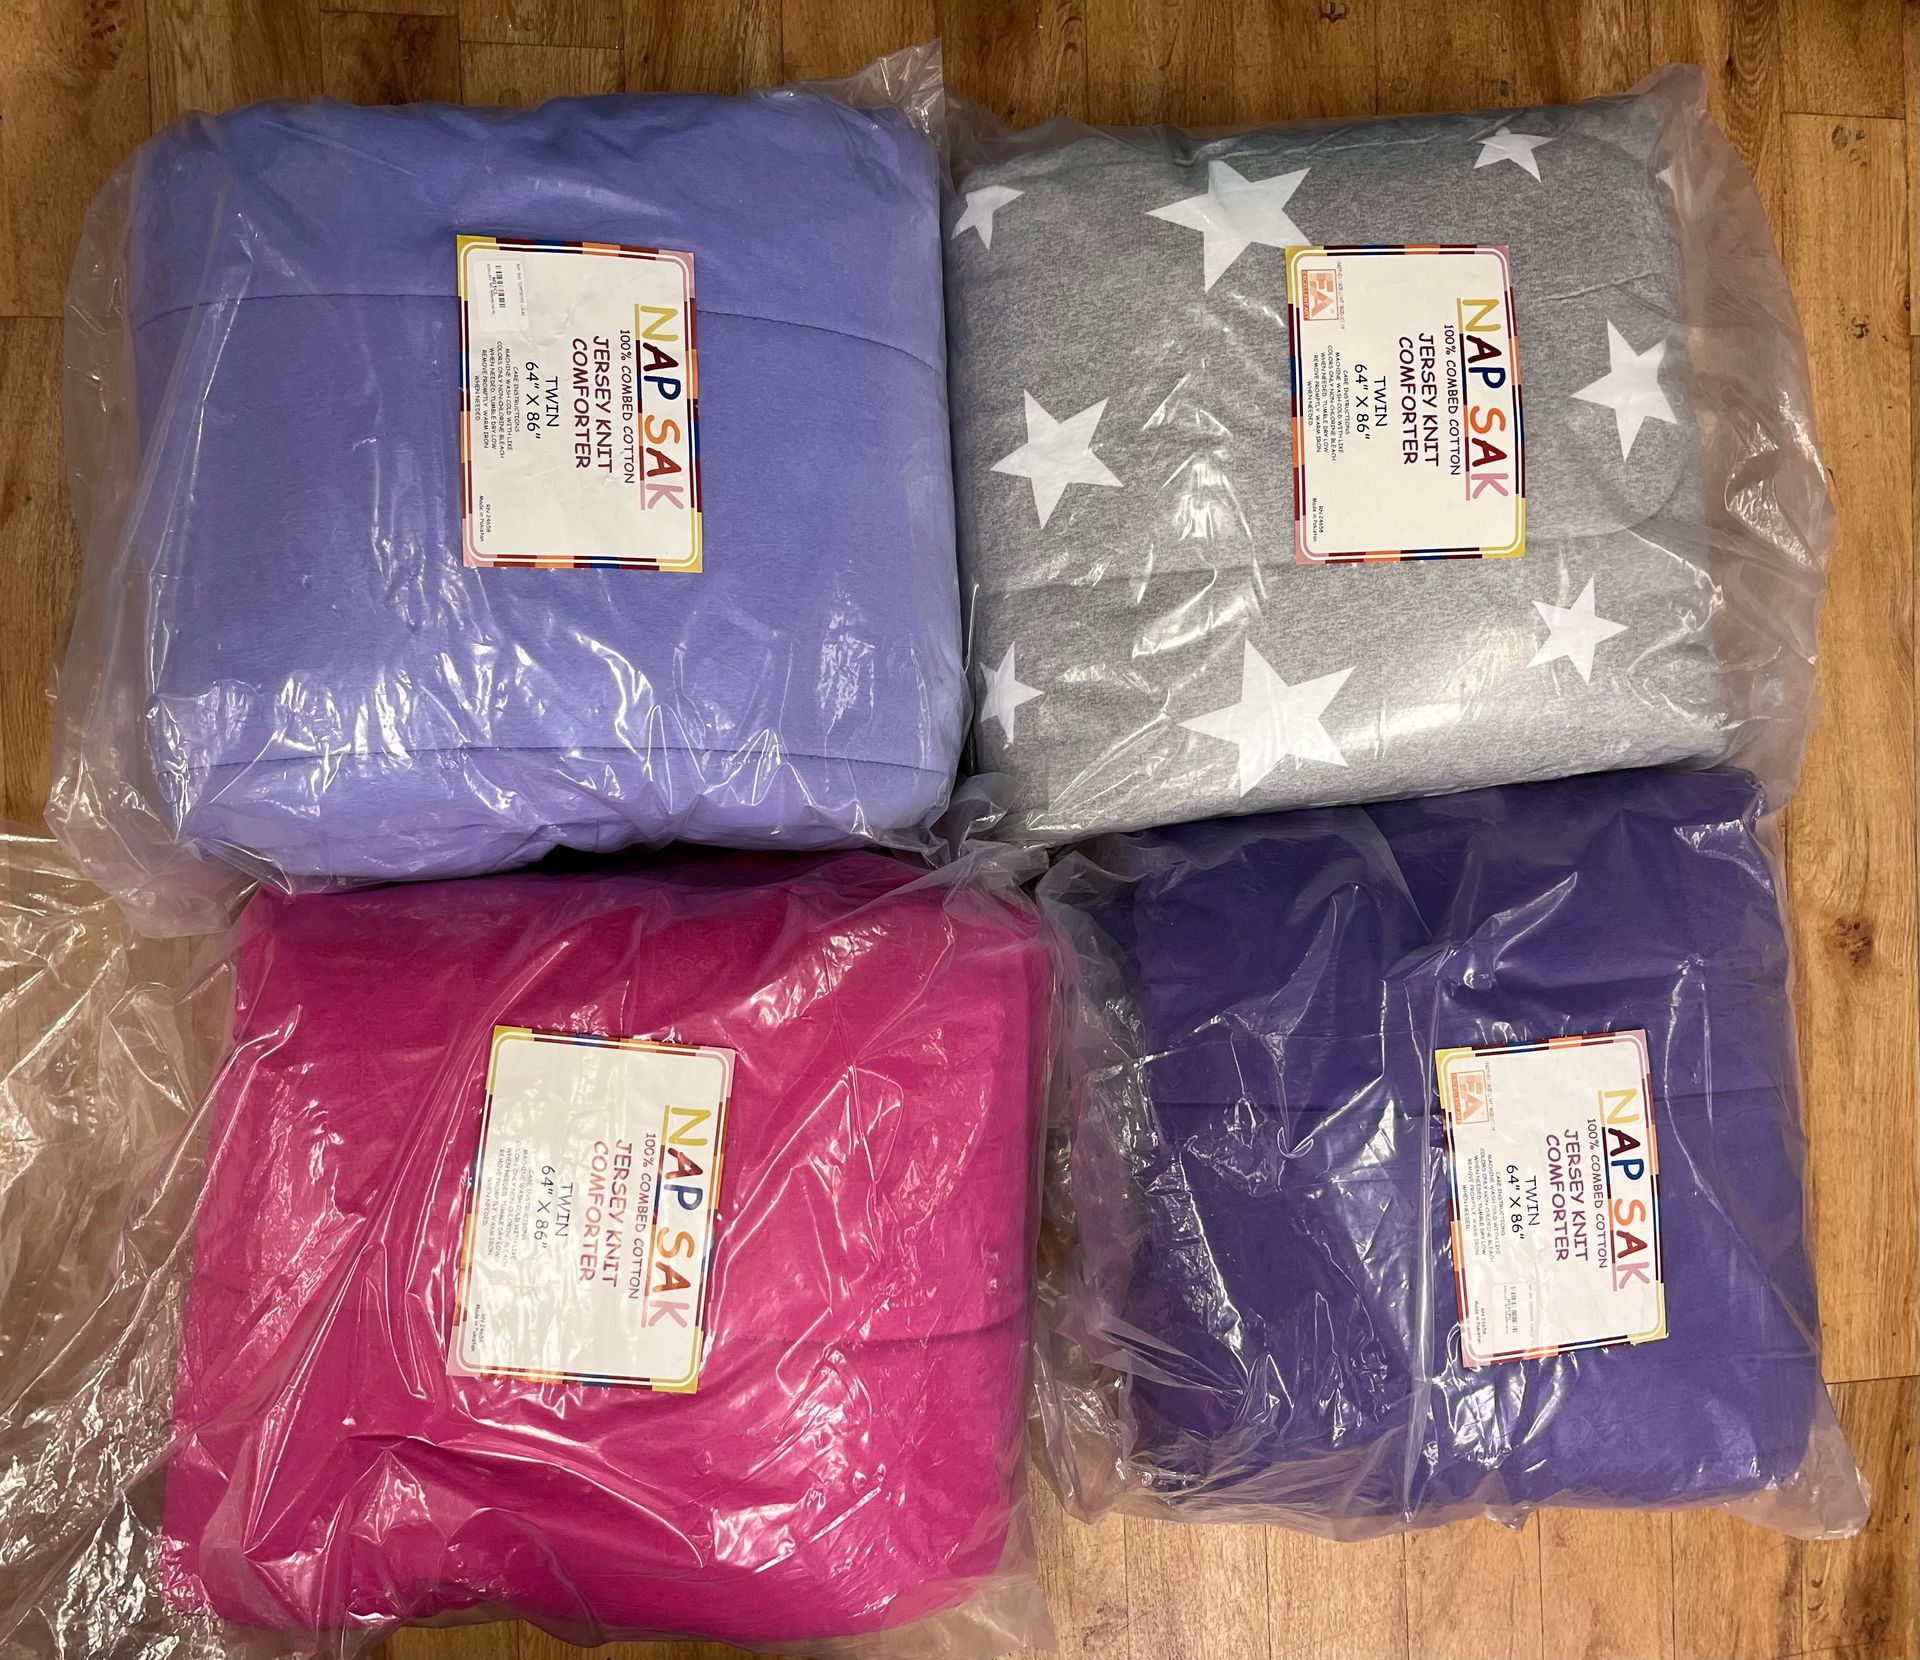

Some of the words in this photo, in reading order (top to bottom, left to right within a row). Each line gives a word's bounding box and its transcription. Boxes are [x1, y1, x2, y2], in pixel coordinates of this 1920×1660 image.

[619, 329, 631, 360] 100%
[640, 305, 681, 400] NAP
[1443, 324, 1456, 355] 100%
[1461, 298, 1506, 390] NAP
[592, 335, 611, 413] JERSEY
[620, 365, 633, 420] COMBED
[1418, 332, 1437, 408] JERSEY
[1446, 359, 1458, 414] COMBED
[526, 393, 539, 406] X
[545, 375, 559, 426] TWIN
[572, 337, 590, 468] COMFORTER
[1355, 396, 1368, 407] X
[1373, 375, 1387, 426] TWIN
[1398, 336, 1418, 464] COMFORTER
[595, 418, 612, 473] KNIT
[622, 425, 635, 483] COTTON
[643, 414, 684, 509] SAK
[1422, 414, 1438, 466] KNIT
[1448, 418, 1460, 475] COTTON
[1466, 404, 1509, 499] SAK
[642, 1132, 656, 1167] 100%
[663, 1106, 711, 1210] NAP
[1586, 1118, 1599, 1150] 100%
[1603, 1087, 1644, 1183] NAP
[608, 1139, 632, 1223] JERSEY
[1563, 1128, 1584, 1203] JERSEY
[1590, 1154, 1603, 1208] COMBED
[536, 1199, 551, 1213] X
[554, 1181, 573, 1236] TWIN
[578, 1140, 608, 1280] COMFORTER
[634, 1172, 651, 1232] COMBED
[1509, 1196, 1521, 1208] X
[1524, 1175, 1540, 1225] TWIN
[1545, 1134, 1569, 1261] COMFORTER
[601, 1229, 622, 1287] KNIT
[1571, 1210, 1588, 1261] KNIT
[1595, 1213, 1607, 1268] COTTON
[1610, 1197, 1650, 1289] SAK
[628, 1237, 644, 1298] COTTON
[644, 1226, 695, 1328] SAK
